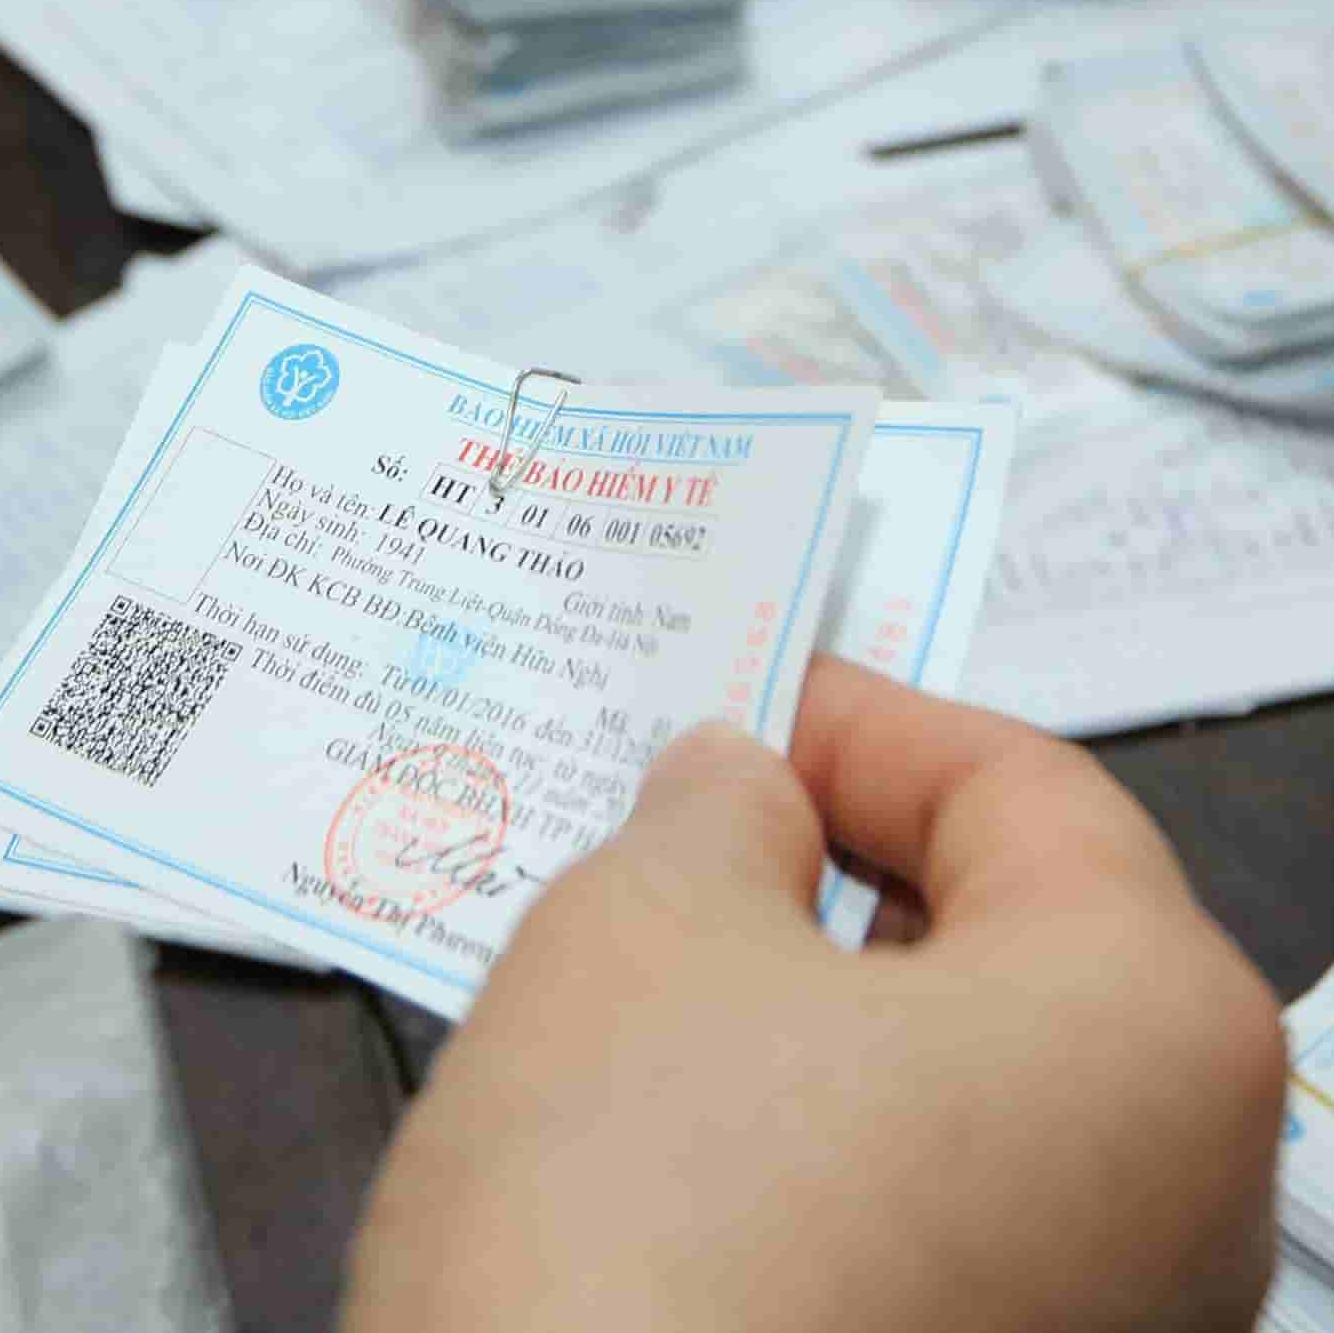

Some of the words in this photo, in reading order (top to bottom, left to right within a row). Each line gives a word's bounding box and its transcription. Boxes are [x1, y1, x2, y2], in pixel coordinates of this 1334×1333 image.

[271, 465, 304, 496] Họ
[377, 503, 416, 531] LÊ
[416, 517, 513, 564] QUANG
[370, 454, 409, 483] Số:
[431, 475, 476, 504] HT
[520, 504, 549, 530] 01
[567, 512, 596, 539] 06
[523, 457, 585, 491] BẢO
[587, 465, 659, 504] HIỂM
[663, 473, 682, 506] Y
[242, 511, 281, 542] Địa
[256, 488, 315, 527] Ngày
[375, 533, 427, 567] 1941
[223, 540, 266, 572] Nơi
[307, 573, 362, 608] KCB
[194, 591, 244, 627] Thời
[243, 611, 280, 643] hạn
[250, 646, 301, 683] Thời
[384, 699, 416, 723] 05
